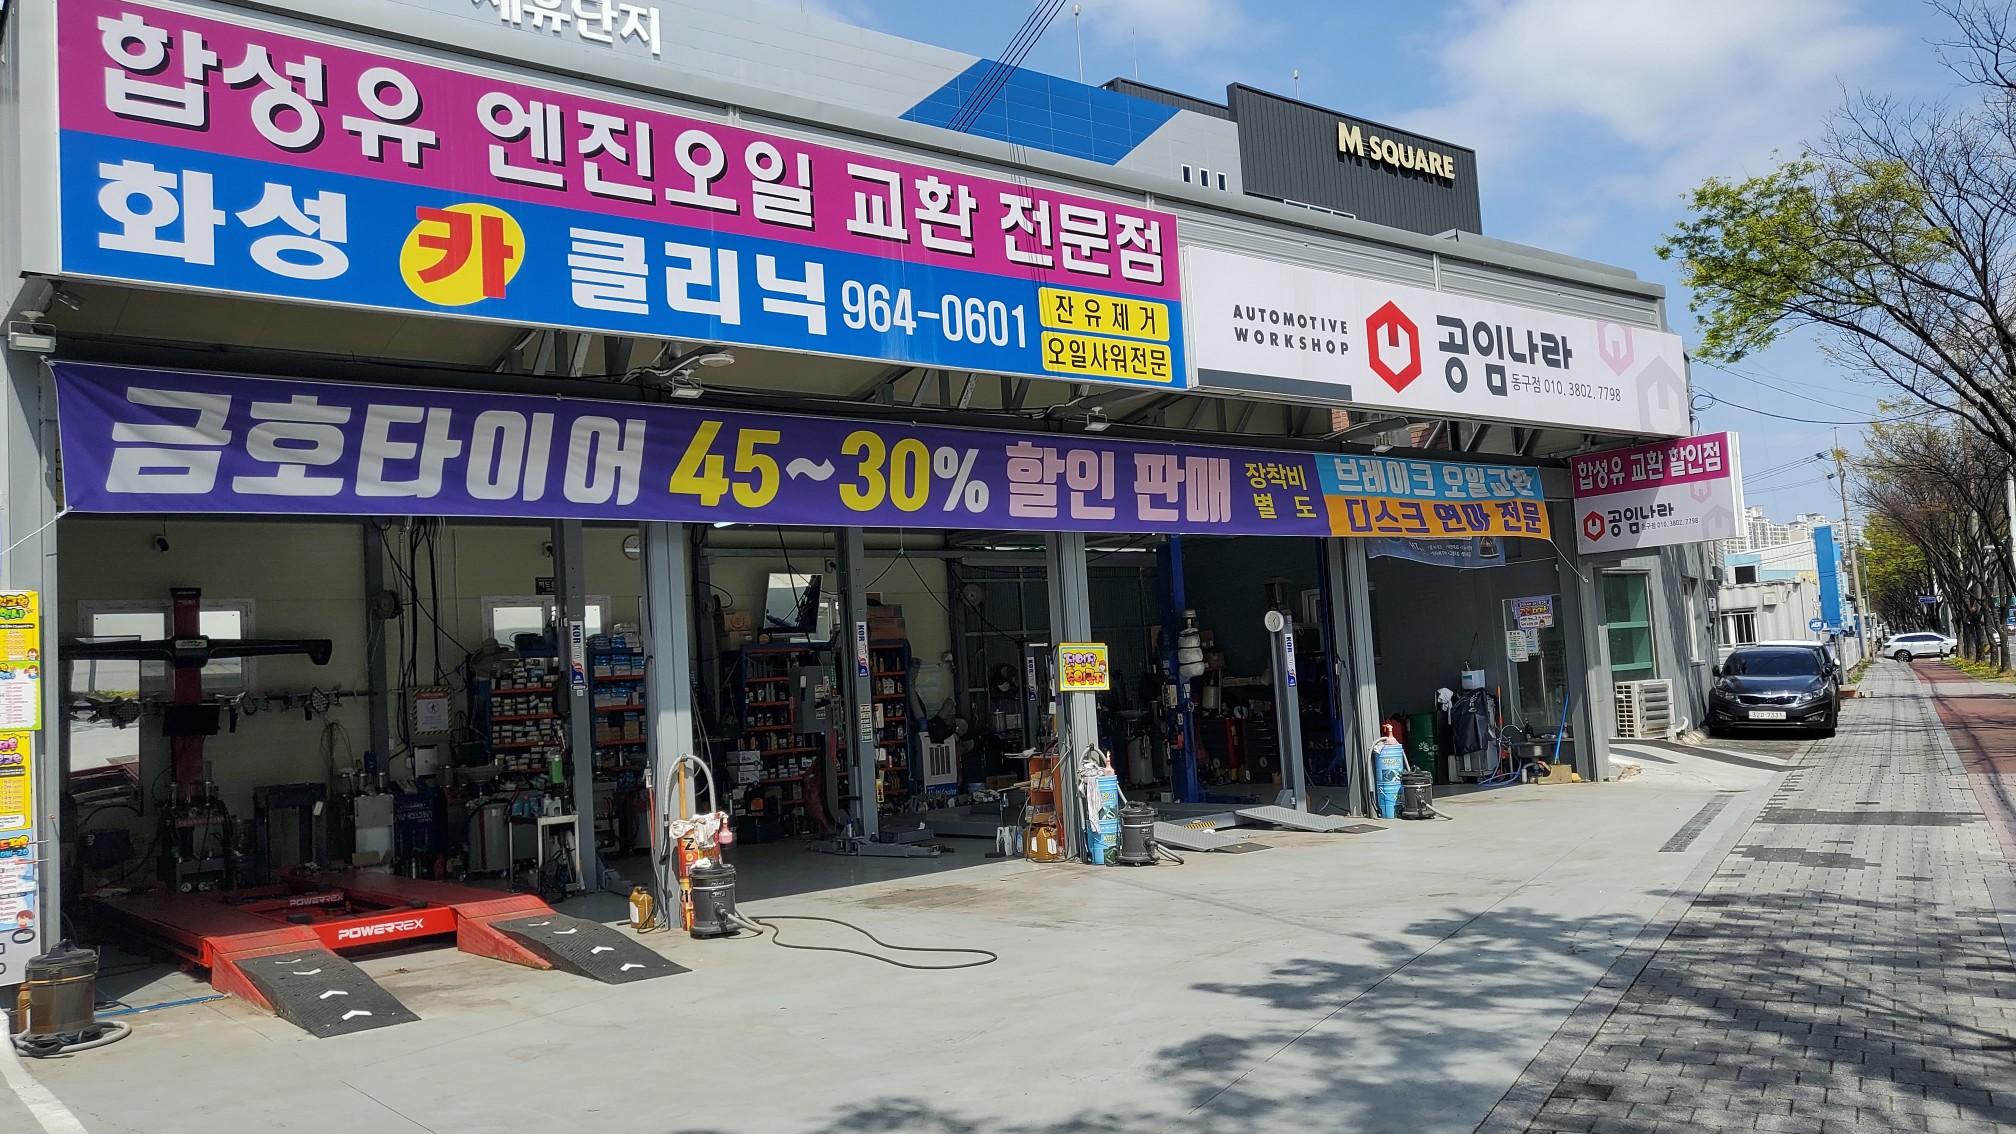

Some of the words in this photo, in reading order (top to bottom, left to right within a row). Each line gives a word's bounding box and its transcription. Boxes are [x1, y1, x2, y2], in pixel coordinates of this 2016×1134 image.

[98, 12, 438, 165] 합성유
[477, 92, 814, 229] 엔진오일
[847, 163, 978, 256] 교환
[1001, 192, 1163, 284] 전문점
[1338, 121, 1365, 157] M
[1369, 135, 1456, 180] SQUARE
[98, 160, 349, 279] 화성
[417, 207, 513, 299] 카
[567, 227, 828, 335] 클리닉
[842, 279, 1026, 349] 964-0601
[1233, 304, 1348, 334] AUTOMOTIVE
[1234, 327, 1349, 355] WORKSHOP
[1436, 315, 1573, 397] 공임나라
[1511, 373, 1541, 394] 동구점
[106, 386, 646, 505] 금호타이어
[669, 420, 990, 513] 45~30%
[1006, 441, 1116, 521] 할인
[1134, 452, 1231, 523] 판매
[1578, 456, 1625, 490] 합성유
[1630, 451, 1664, 482] 교환
[1669, 441, 1722, 477] 할인점
[1245, 462, 1308, 490] 장착비
[1334, 458, 1436, 497] 브레이크
[1444, 466, 1535, 498] 오일교환
[1344, 498, 1431, 533] 디스크
[1433, 501, 1491, 533] 연마
[1496, 501, 1542, 534] 전문
[1607, 502, 1675, 538] 공임나라
[289, 891, 345, 907] POWERREX
[338, 917, 424, 941] POWERREX
